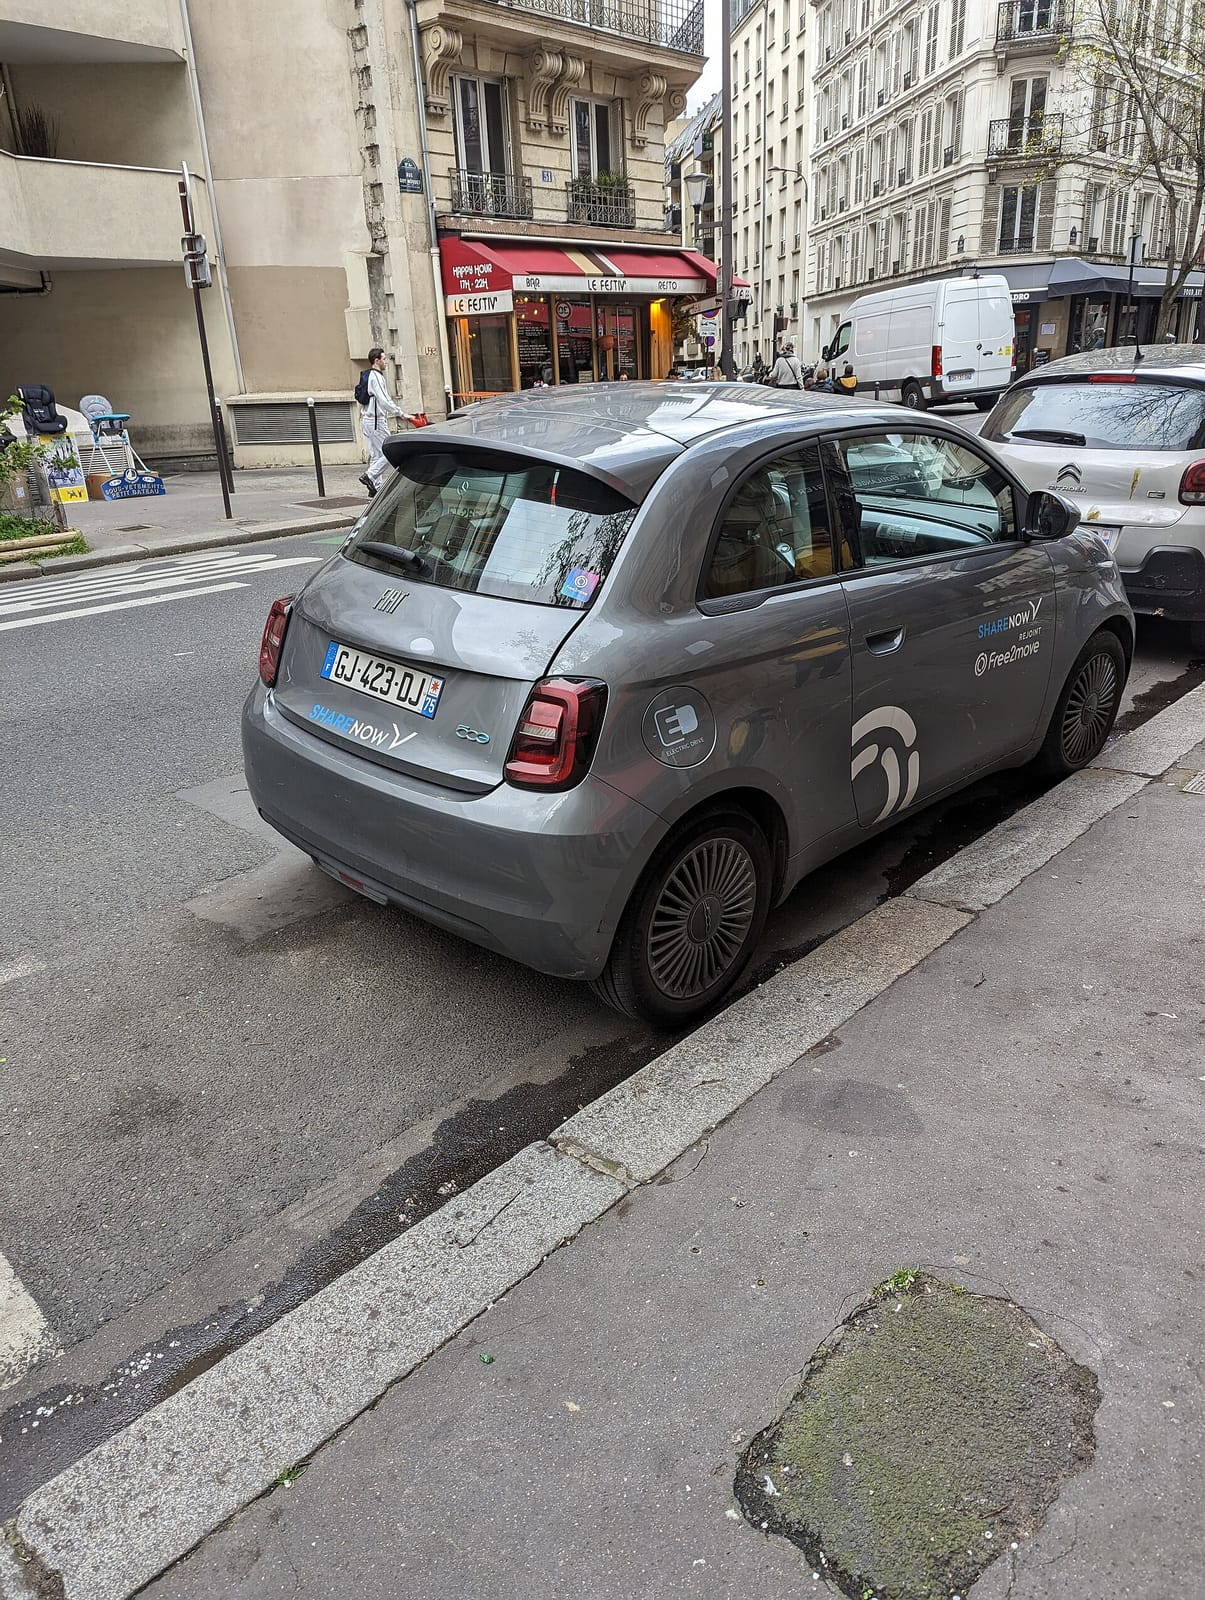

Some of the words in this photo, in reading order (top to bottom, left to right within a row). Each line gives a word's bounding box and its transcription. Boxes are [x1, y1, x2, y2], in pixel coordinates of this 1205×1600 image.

[452, 265, 473, 278] HAPPY
[474, 263, 493, 276] HOUR
[475, 278, 489, 290] 22H
[525, 277, 541, 290] BAR
[587, 279, 597, 291] LE
[657, 281, 678, 290] RESTO
[454, 299, 464, 312] LE
[372, 587, 410, 614] FIAT
[1018, 626, 1042, 641] REJOINT
[987, 641, 1040, 670] Free2move
[424, 697, 436, 713] 75
[665, 742, 691, 757] ELECTRIC
[690, 736, 705, 747] DRIVE
